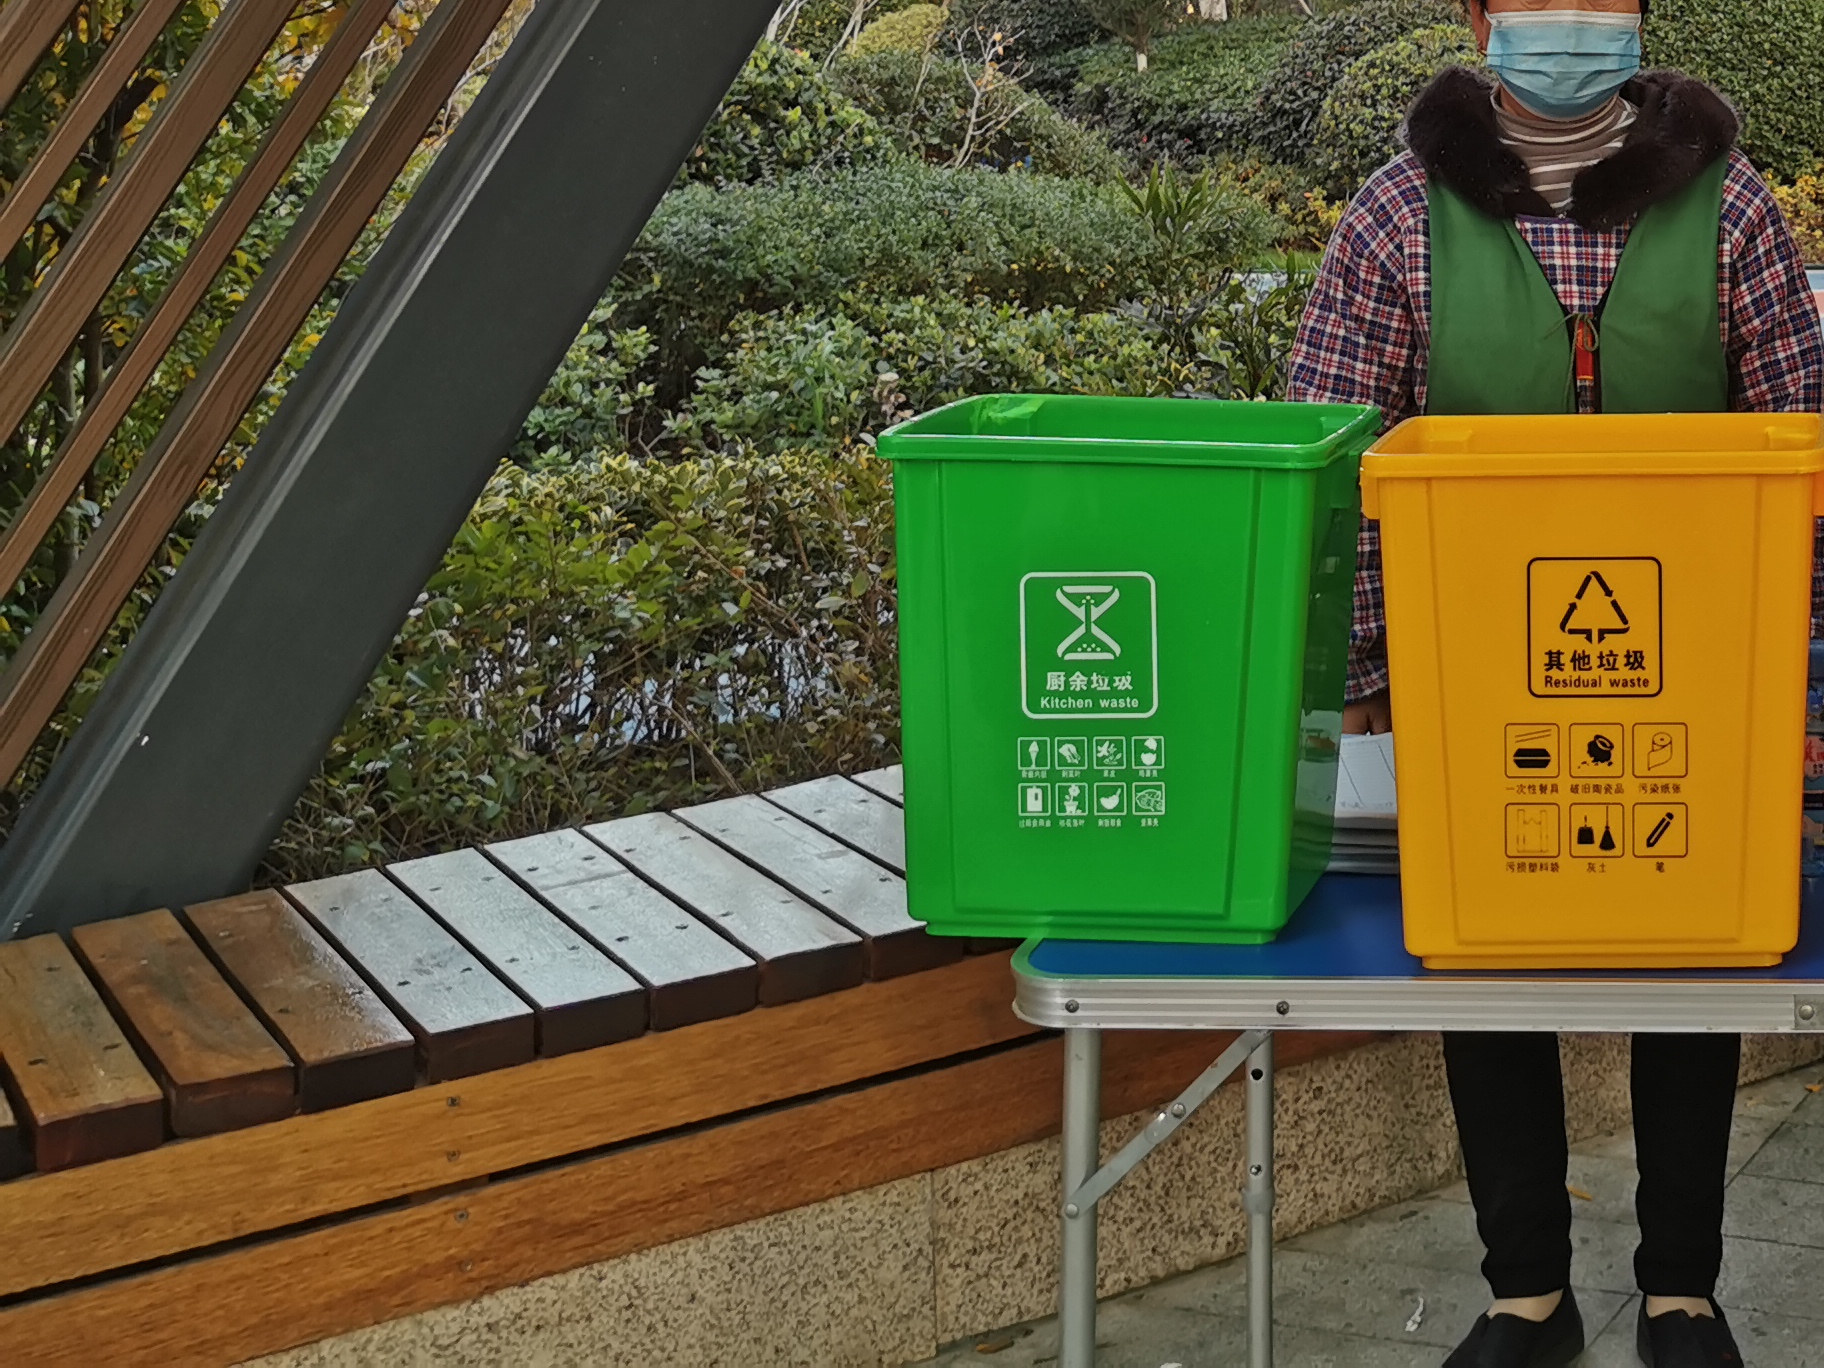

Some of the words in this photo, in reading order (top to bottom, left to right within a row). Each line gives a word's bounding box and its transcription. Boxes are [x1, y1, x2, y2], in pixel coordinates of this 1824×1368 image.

[1544, 649, 1646, 672] 其他垃圾
[1046, 671, 1133, 691] 厨余垃圾
[1544, 675, 1602, 688] Residual
[1609, 676, 1650, 688] waste
[1040, 696, 1093, 709] Kitchen
[1100, 697, 1139, 708] waste
[1505, 783, 1559, 795] 一次性餐具
[1570, 783, 1625, 795] 破旧陶瓷品
[1638, 783, 1682, 795] 污染纸张
[1505, 861, 1560, 873] 污损塑料袋
[1586, 862, 1607, 873] 灰土
[1655, 861, 1665, 873] 笔
